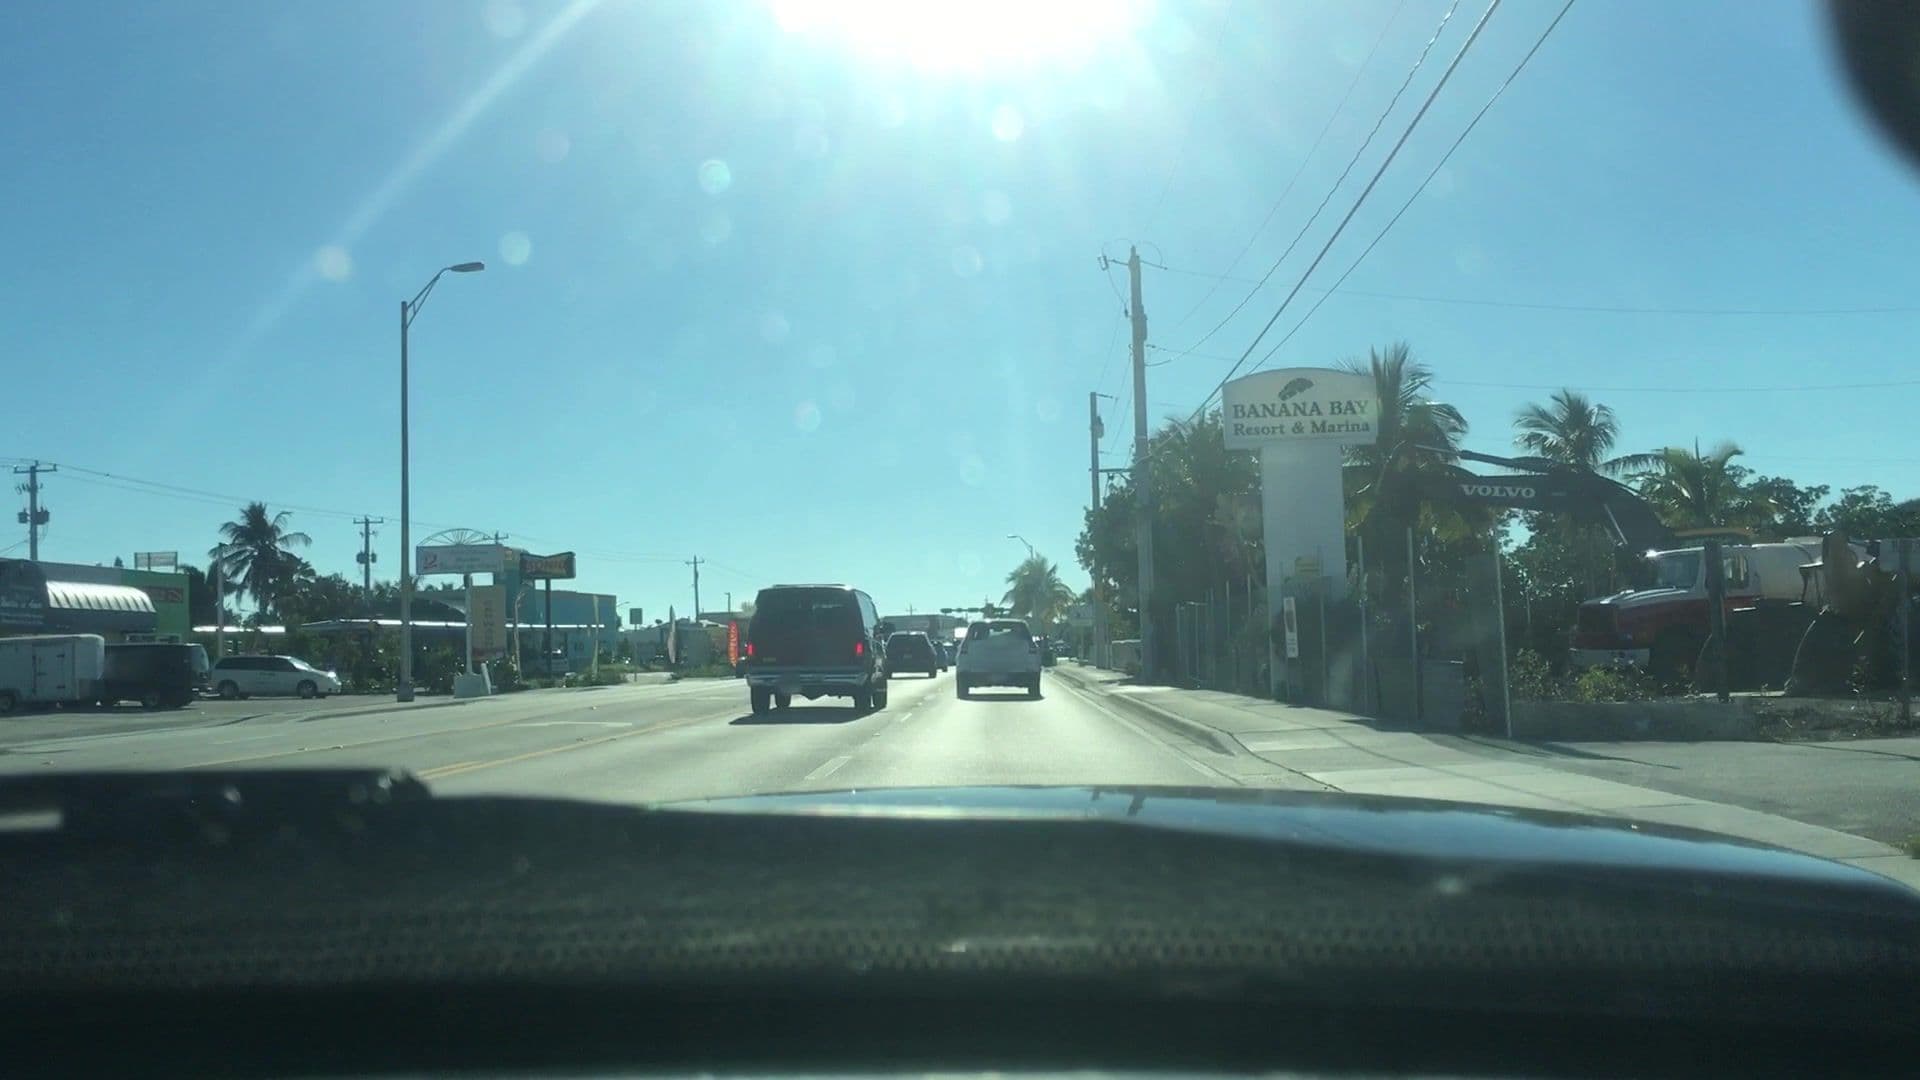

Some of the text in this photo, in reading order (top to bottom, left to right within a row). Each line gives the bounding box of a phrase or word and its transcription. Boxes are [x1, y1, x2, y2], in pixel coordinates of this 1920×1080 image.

[1232, 398, 1369, 419] BANANA BAY
[1233, 417, 1370, 435] Resort & Marina
[1461, 484, 1537, 498] VOLVO
